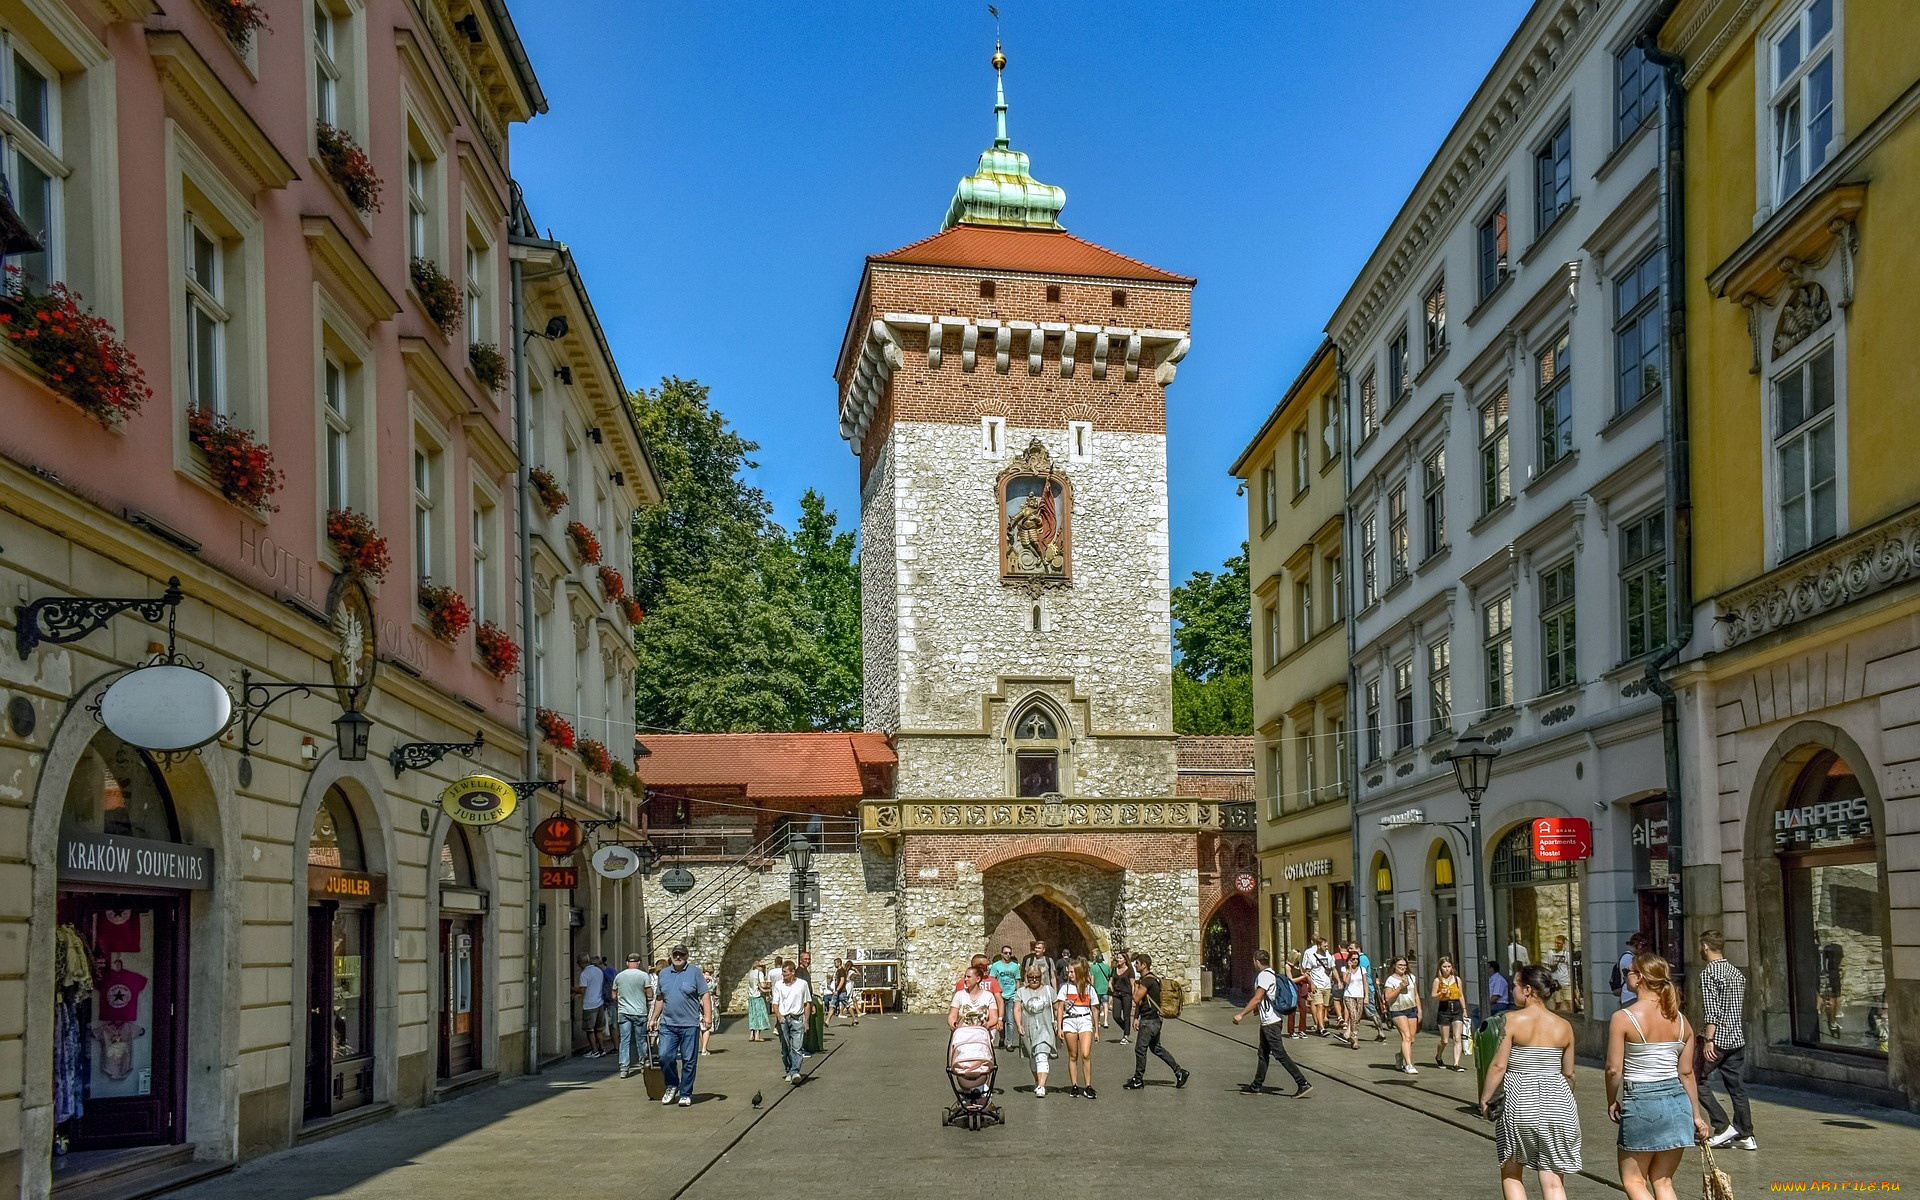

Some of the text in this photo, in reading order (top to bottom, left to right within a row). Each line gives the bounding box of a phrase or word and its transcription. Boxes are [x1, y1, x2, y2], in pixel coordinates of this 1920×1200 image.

[239, 520, 431, 674] HOTEL POLSKI
[449, 780, 510, 798] JEWELLERY
[453, 808, 505, 821] JUBILER
[1775, 797, 1868, 830] HARPERS
[1775, 821, 1871, 844] SHOES
[68, 839, 203, 881] KRAKÓW SOUVENIRS
[1284, 858, 1329, 881] COSTA COFFEE
[327, 876, 370, 896] JUBILER
